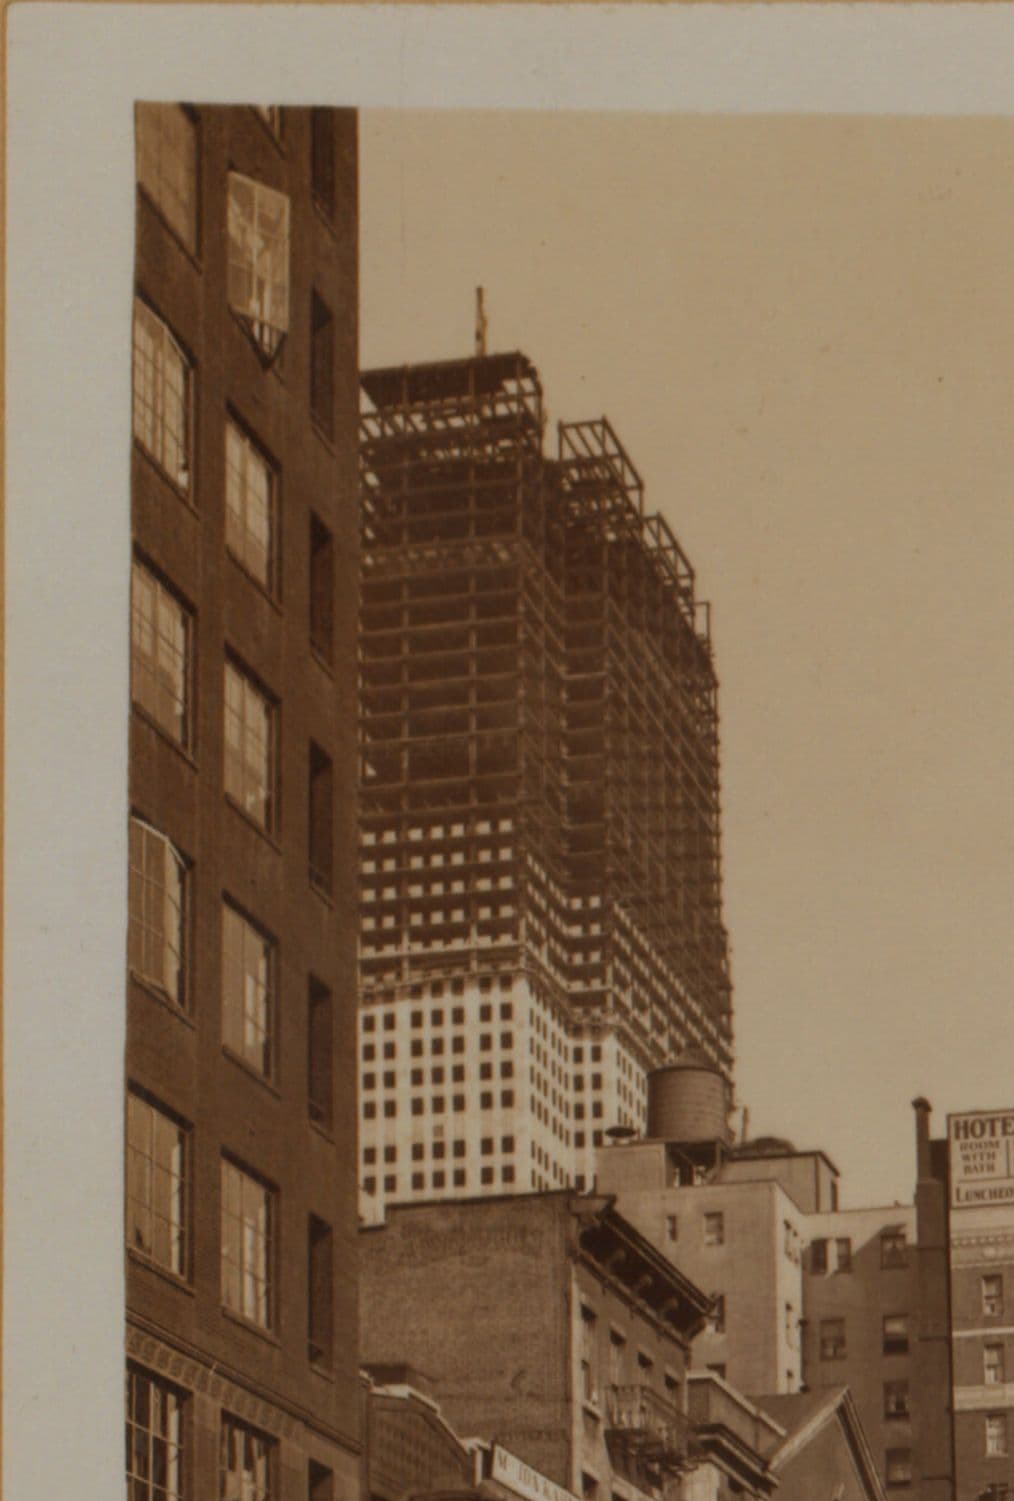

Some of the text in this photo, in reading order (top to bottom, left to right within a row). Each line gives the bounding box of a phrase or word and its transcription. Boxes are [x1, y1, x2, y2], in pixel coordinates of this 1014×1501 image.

[959, 1139, 1000, 1152] ROOM
[961, 1150, 997, 1162] WITH
[963, 1161, 997, 1176] BATH
